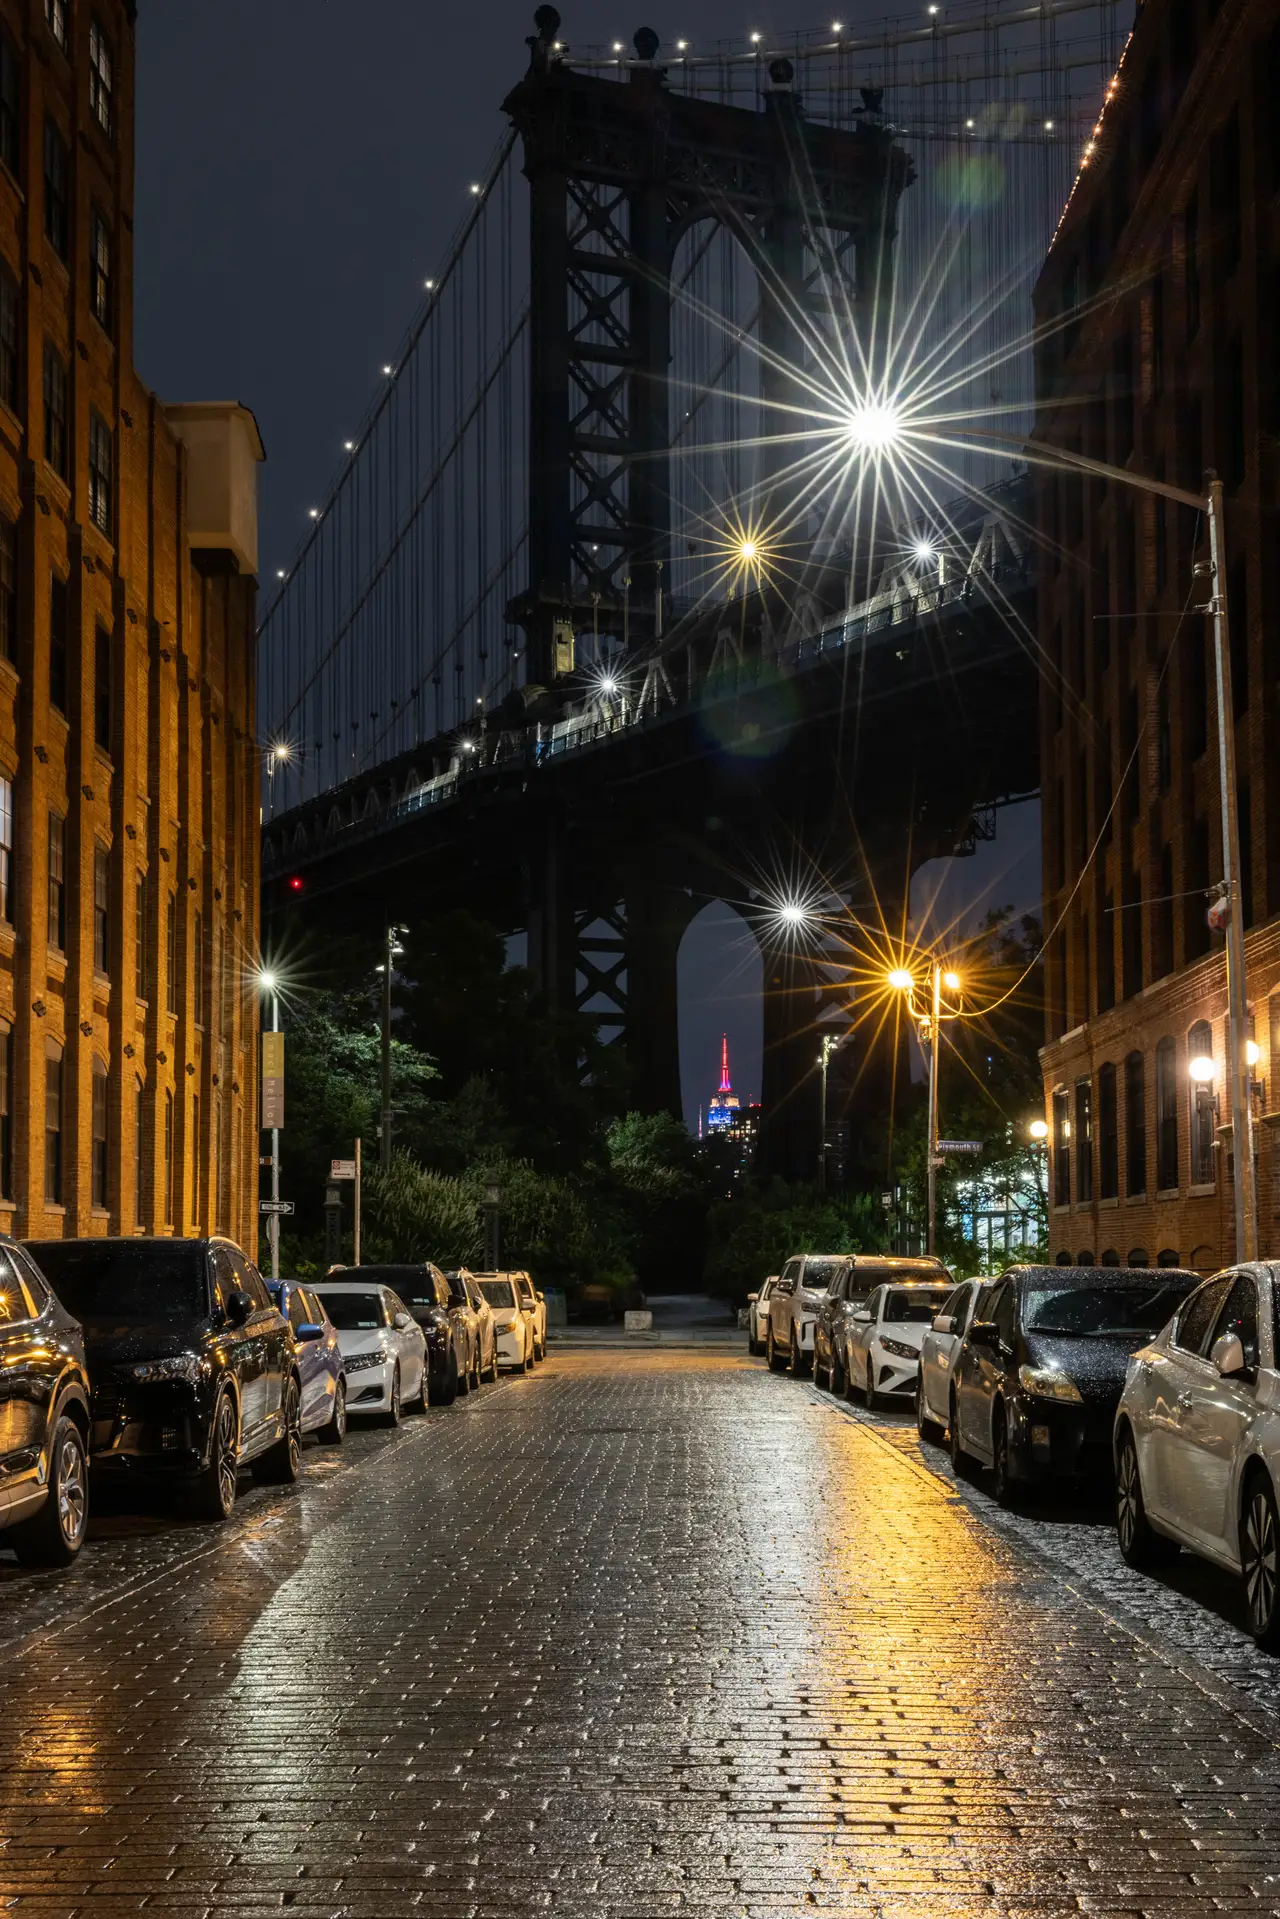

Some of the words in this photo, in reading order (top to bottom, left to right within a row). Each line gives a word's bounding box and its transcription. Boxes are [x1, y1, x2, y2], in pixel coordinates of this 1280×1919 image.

[267, 1036, 276, 1075] Smack
[267, 1080, 276, 1126] Mellon
[939, 1143, 971, 1152] Plymouth
